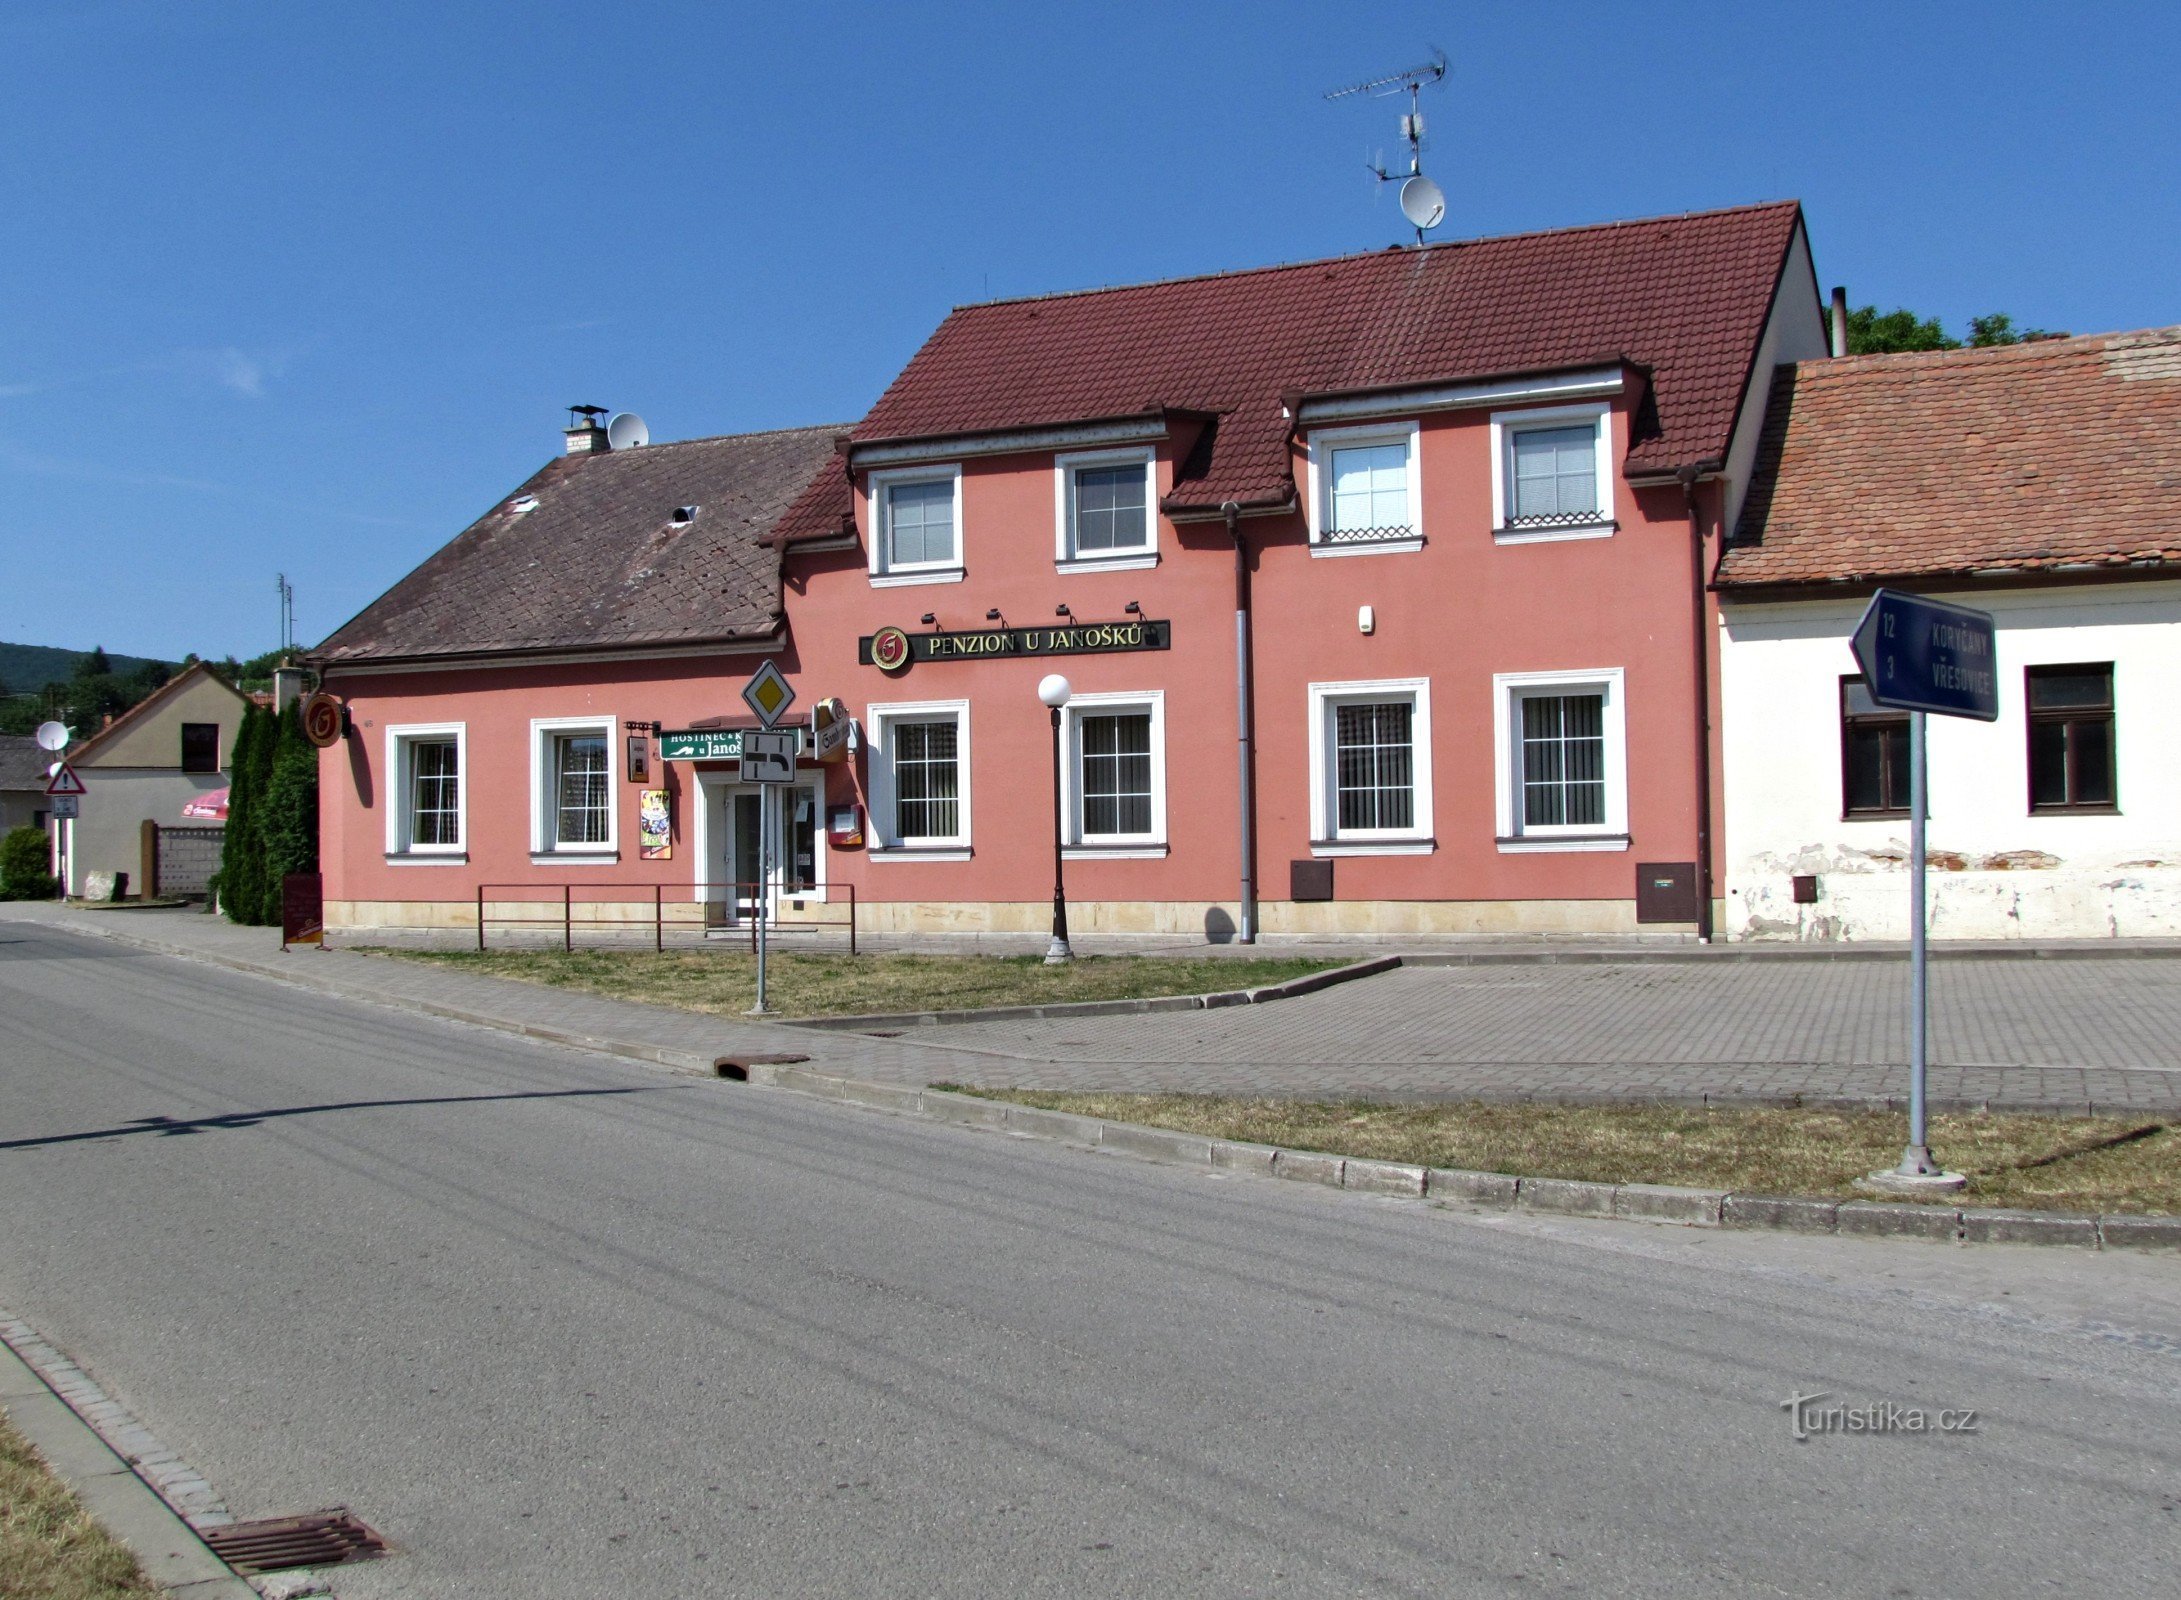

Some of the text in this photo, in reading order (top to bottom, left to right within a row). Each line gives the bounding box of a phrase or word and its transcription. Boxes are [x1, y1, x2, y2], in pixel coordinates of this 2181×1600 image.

[929, 634, 1015, 655] PENZION
[1025, 632, 1040, 650] U
[1048, 623, 1142, 649] JANOŠKŮ
[1883, 612, 1987, 656] 12 KORYČANY
[1887, 655, 1991, 695] 3 VŘESOVICE
[671, 731, 727, 743] HOSTINEC
[706, 740, 741, 758] Janoš
